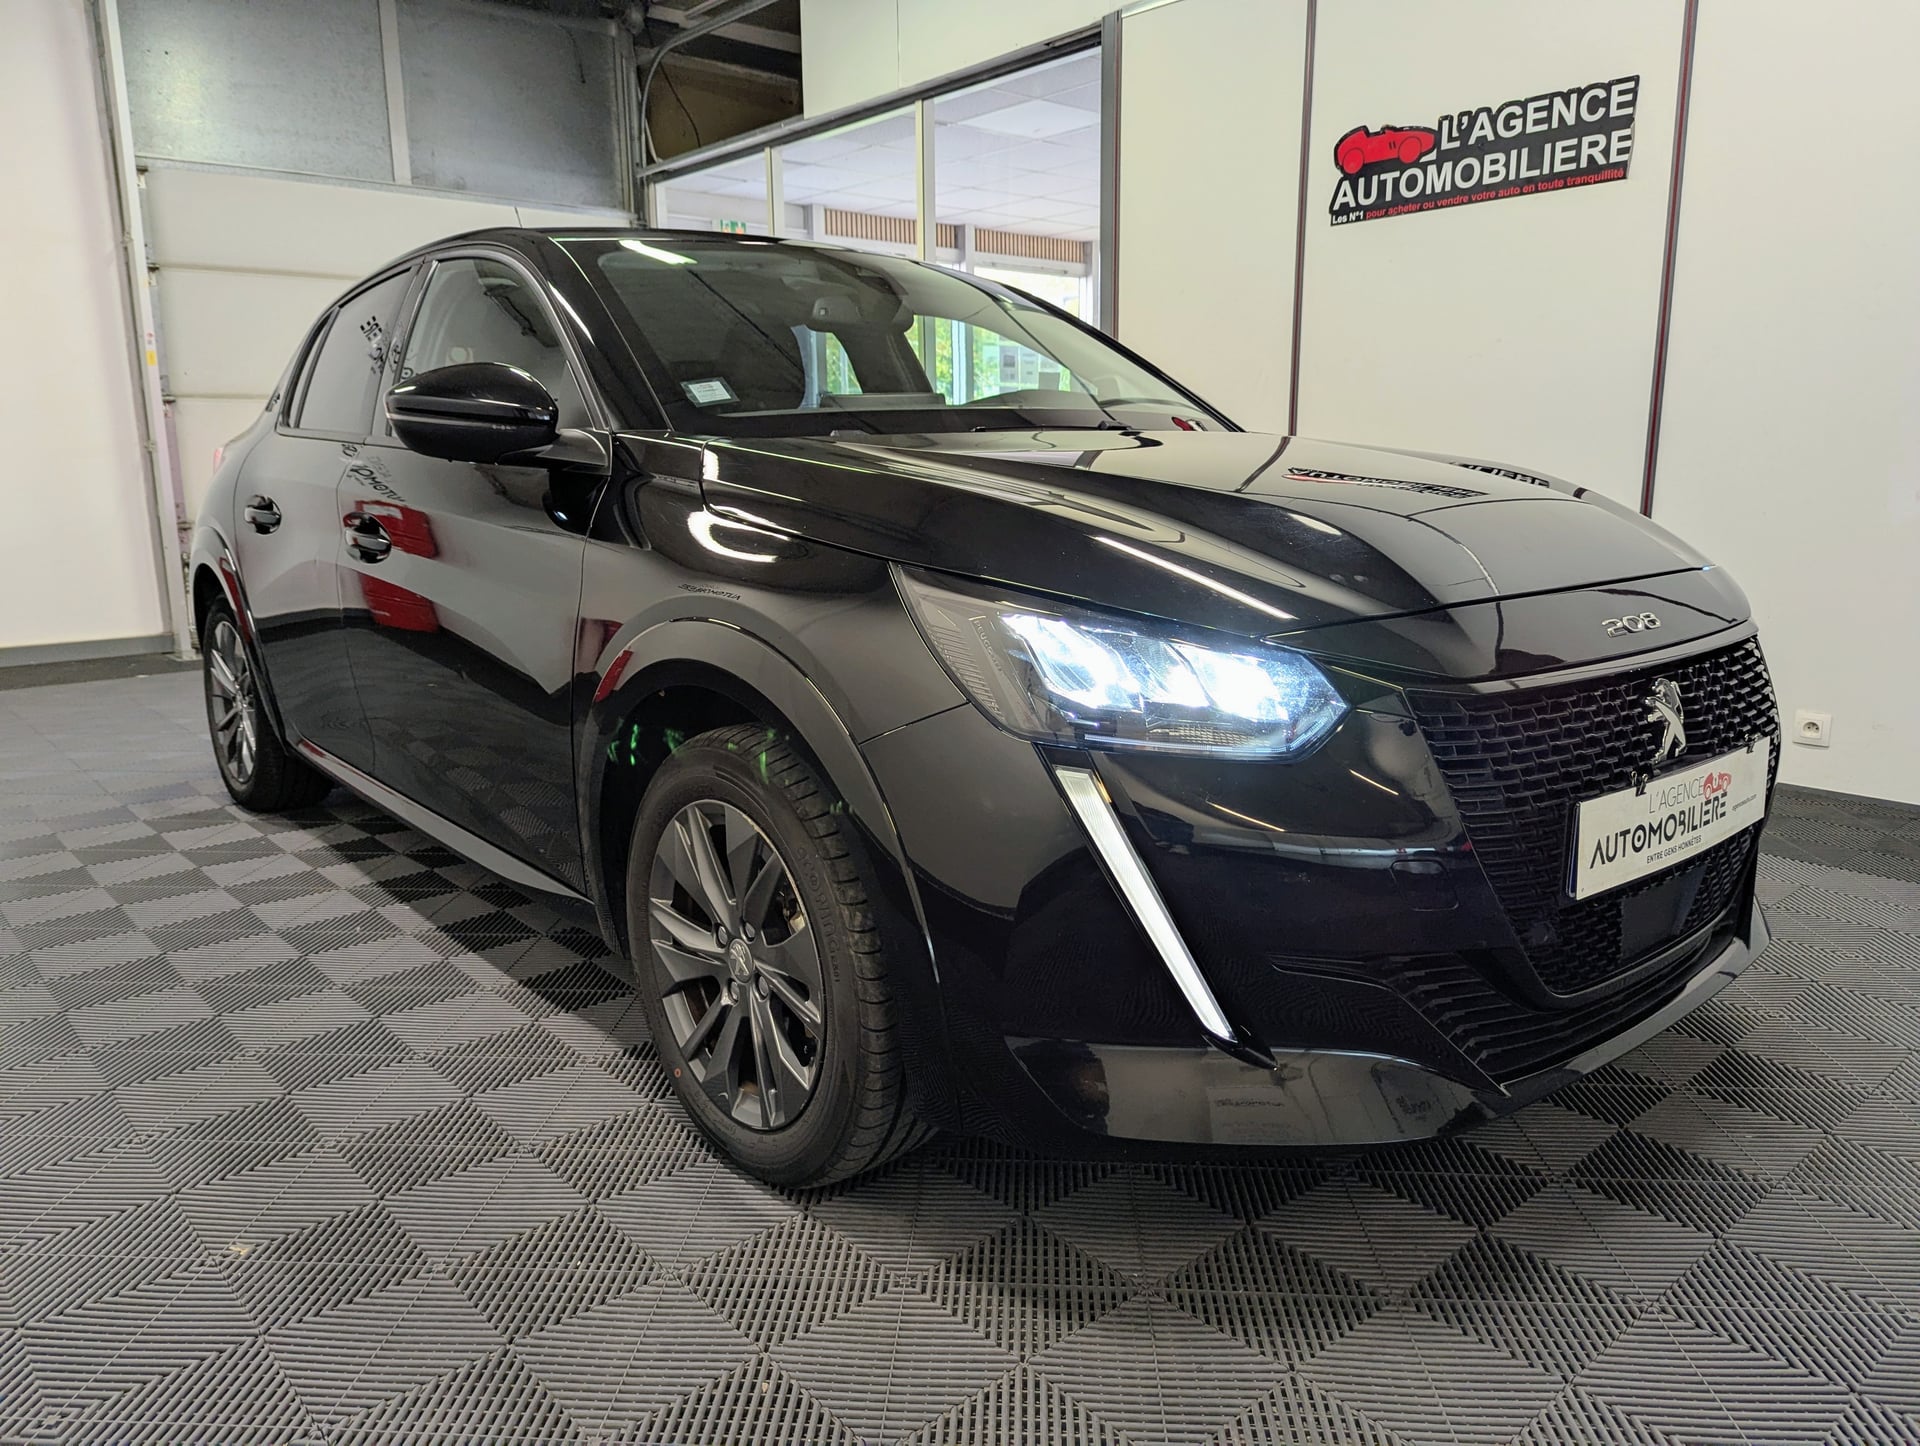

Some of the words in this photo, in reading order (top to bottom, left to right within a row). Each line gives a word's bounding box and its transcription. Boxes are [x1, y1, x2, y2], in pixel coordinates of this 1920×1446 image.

[1440, 80, 1636, 151] L'AGENCE
[1332, 214, 1347, 225] Les
[1365, 208, 1387, 220] pour
[1387, 202, 1422, 216] acheter
[1422, 200, 1435, 210] ou
[1437, 194, 1469, 208] vendre
[1471, 188, 1496, 201] votre
[1497, 184, 1521, 197] auto
[1522, 184, 1536, 193] en
[1538, 177, 1565, 191] toute
[1567, 167, 1625, 186] tranquillité
[1333, 127, 1632, 211] AUTOMOBILIERE
[1601, 611, 1661, 638] 208
[1648, 775, 1705, 814] L'AGENCE
[1590, 791, 1727, 869] AUTOMOBILIERE
[1646, 850, 1664, 864] ENTRE
[1663, 844, 1678, 857] GENS
